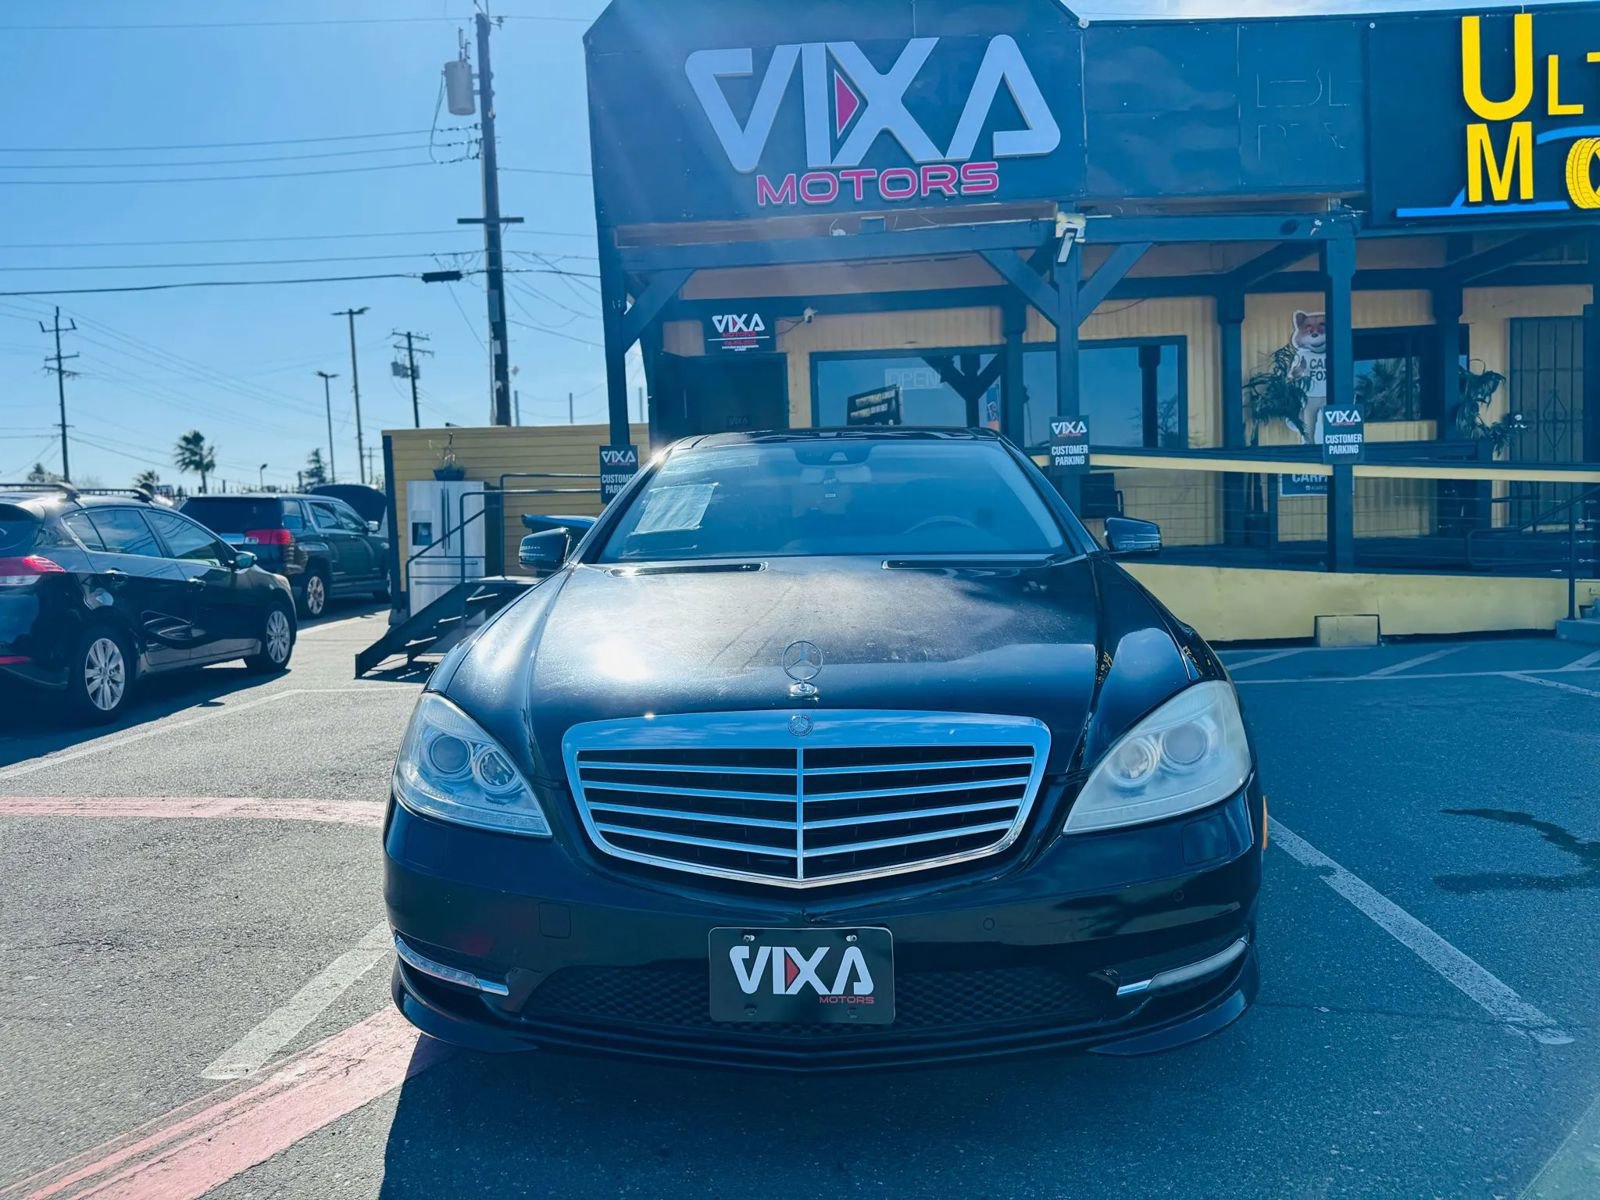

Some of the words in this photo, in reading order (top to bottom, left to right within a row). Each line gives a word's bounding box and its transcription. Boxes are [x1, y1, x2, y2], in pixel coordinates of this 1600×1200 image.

[684, 33, 1062, 174] VIXA
[756, 160, 1000, 207] MOTORS
[711, 312, 766, 334] VIXA
[1309, 358, 1327, 370] CA
[1325, 410, 1362, 424] VIXA
[1051, 420, 1088, 435] VIXA
[1325, 434, 1362, 444] CUSTOMER
[1051, 444, 1089, 456] CUSTOMER
[1328, 444, 1359, 455] PARKING
[600, 450, 636, 463] VIXA
[1055, 455, 1085, 466] PARKING
[601, 474, 634, 484] CUSTOME
[729, 945, 874, 995] VIXA
[818, 996, 875, 1005] MOTORS
